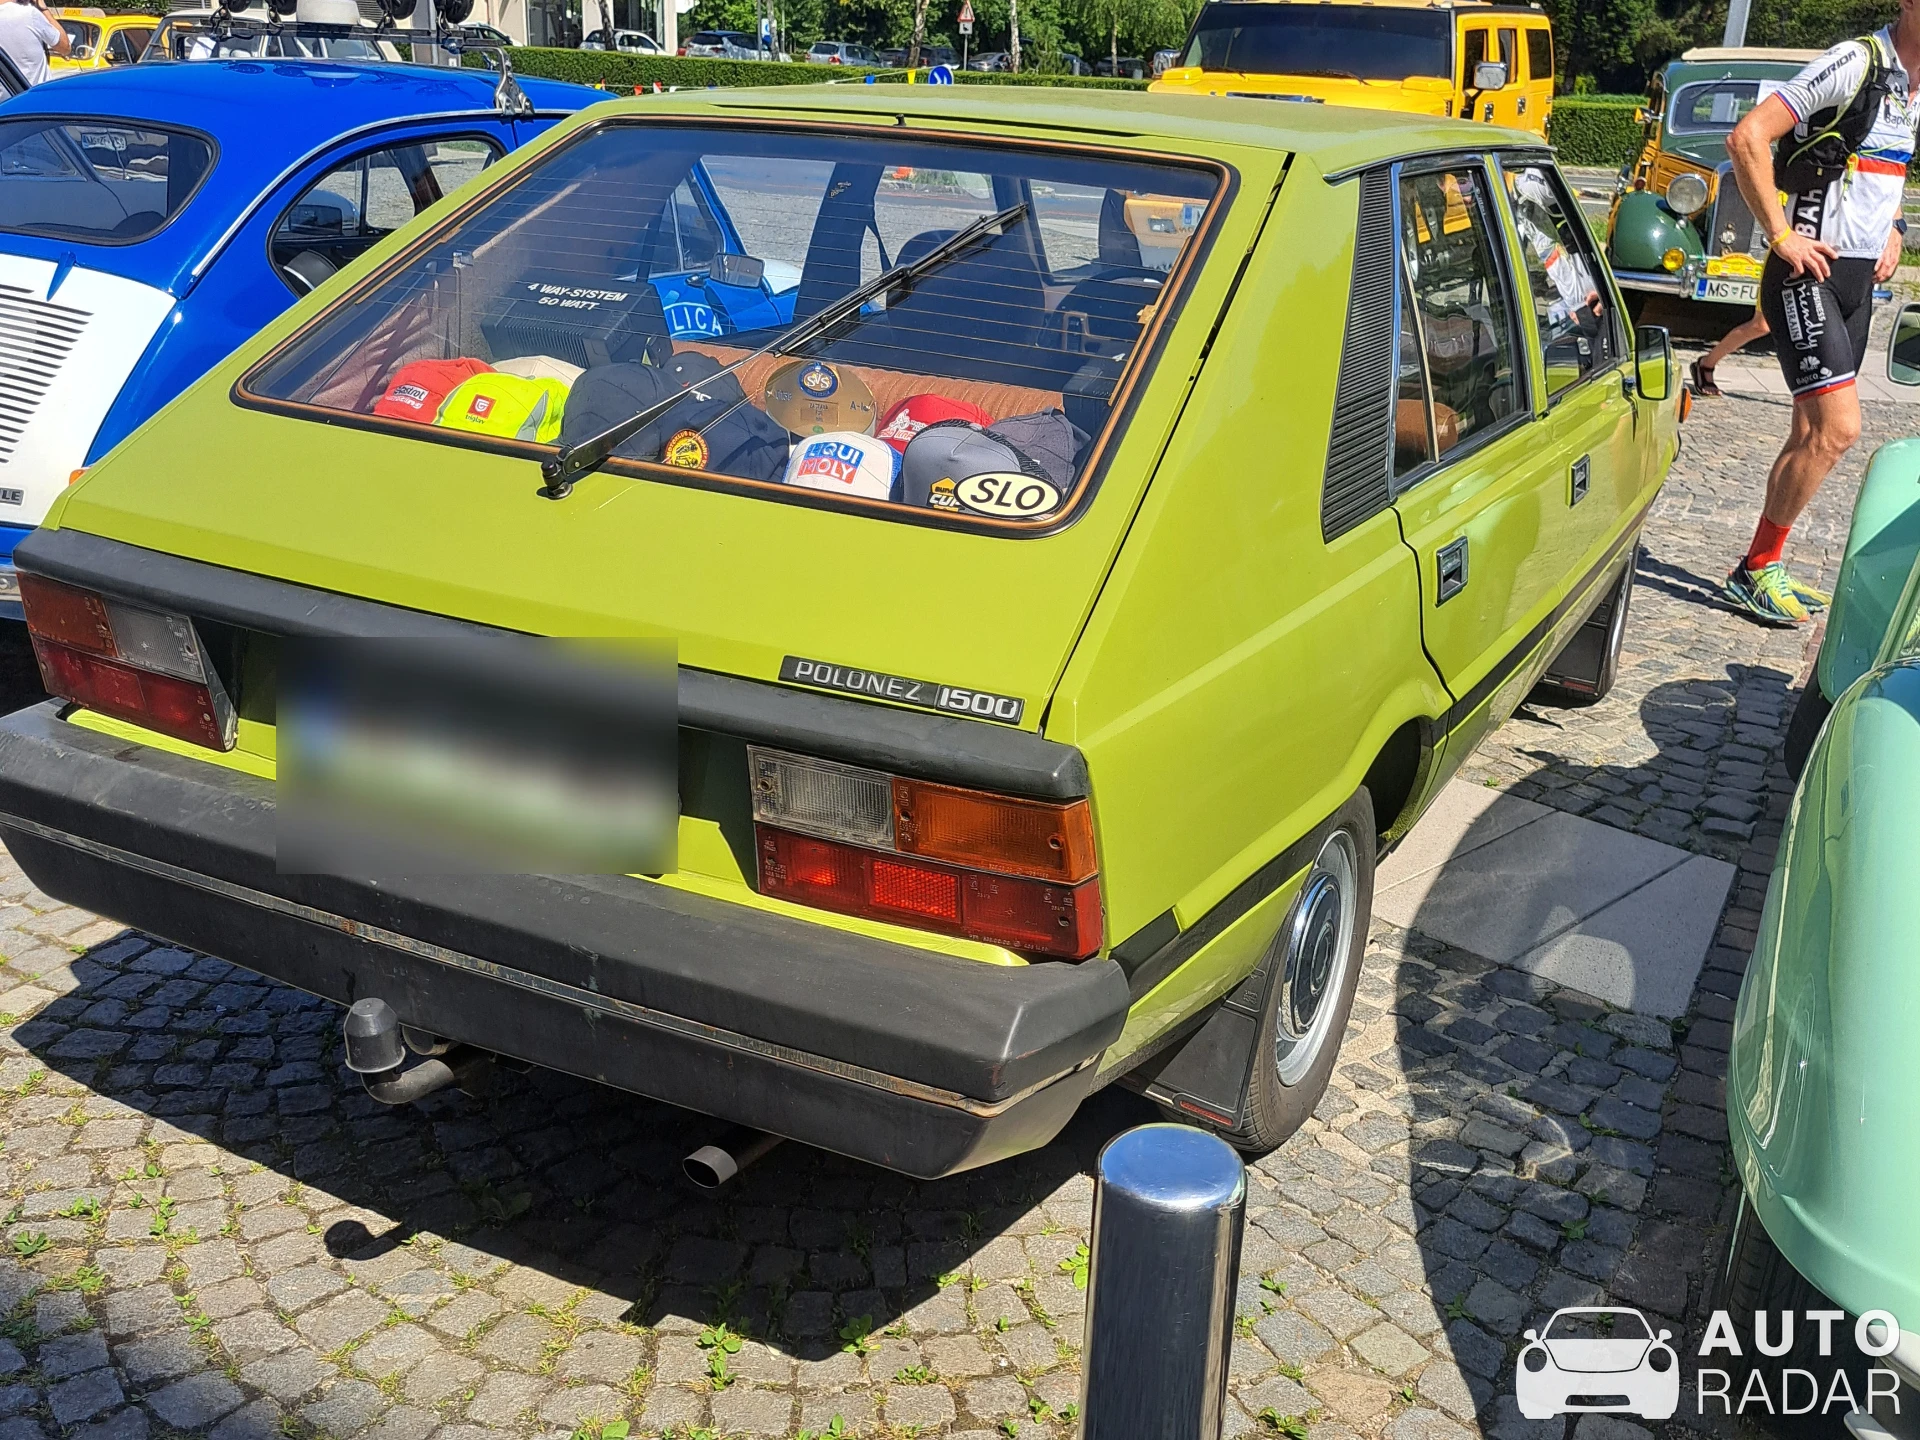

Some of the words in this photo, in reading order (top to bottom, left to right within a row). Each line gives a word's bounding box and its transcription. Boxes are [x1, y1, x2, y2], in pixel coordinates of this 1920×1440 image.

[1807, 50, 1857, 92] MERIDA
[528, 283, 540, 291] 4
[540, 284, 629, 302] WAY-SYSTEM
[1708, 282, 1729, 297] MS
[538, 297, 560, 306] 50
[560, 299, 600, 311] WATT
[1782, 288, 1803, 342] BAHRAIN
[808, 442, 861, 465] LIQUI
[802, 458, 854, 481] MOLY
[970, 477, 1046, 511] SLO
[795, 660, 925, 701] POLONEZ
[939, 686, 1018, 719] 1500
